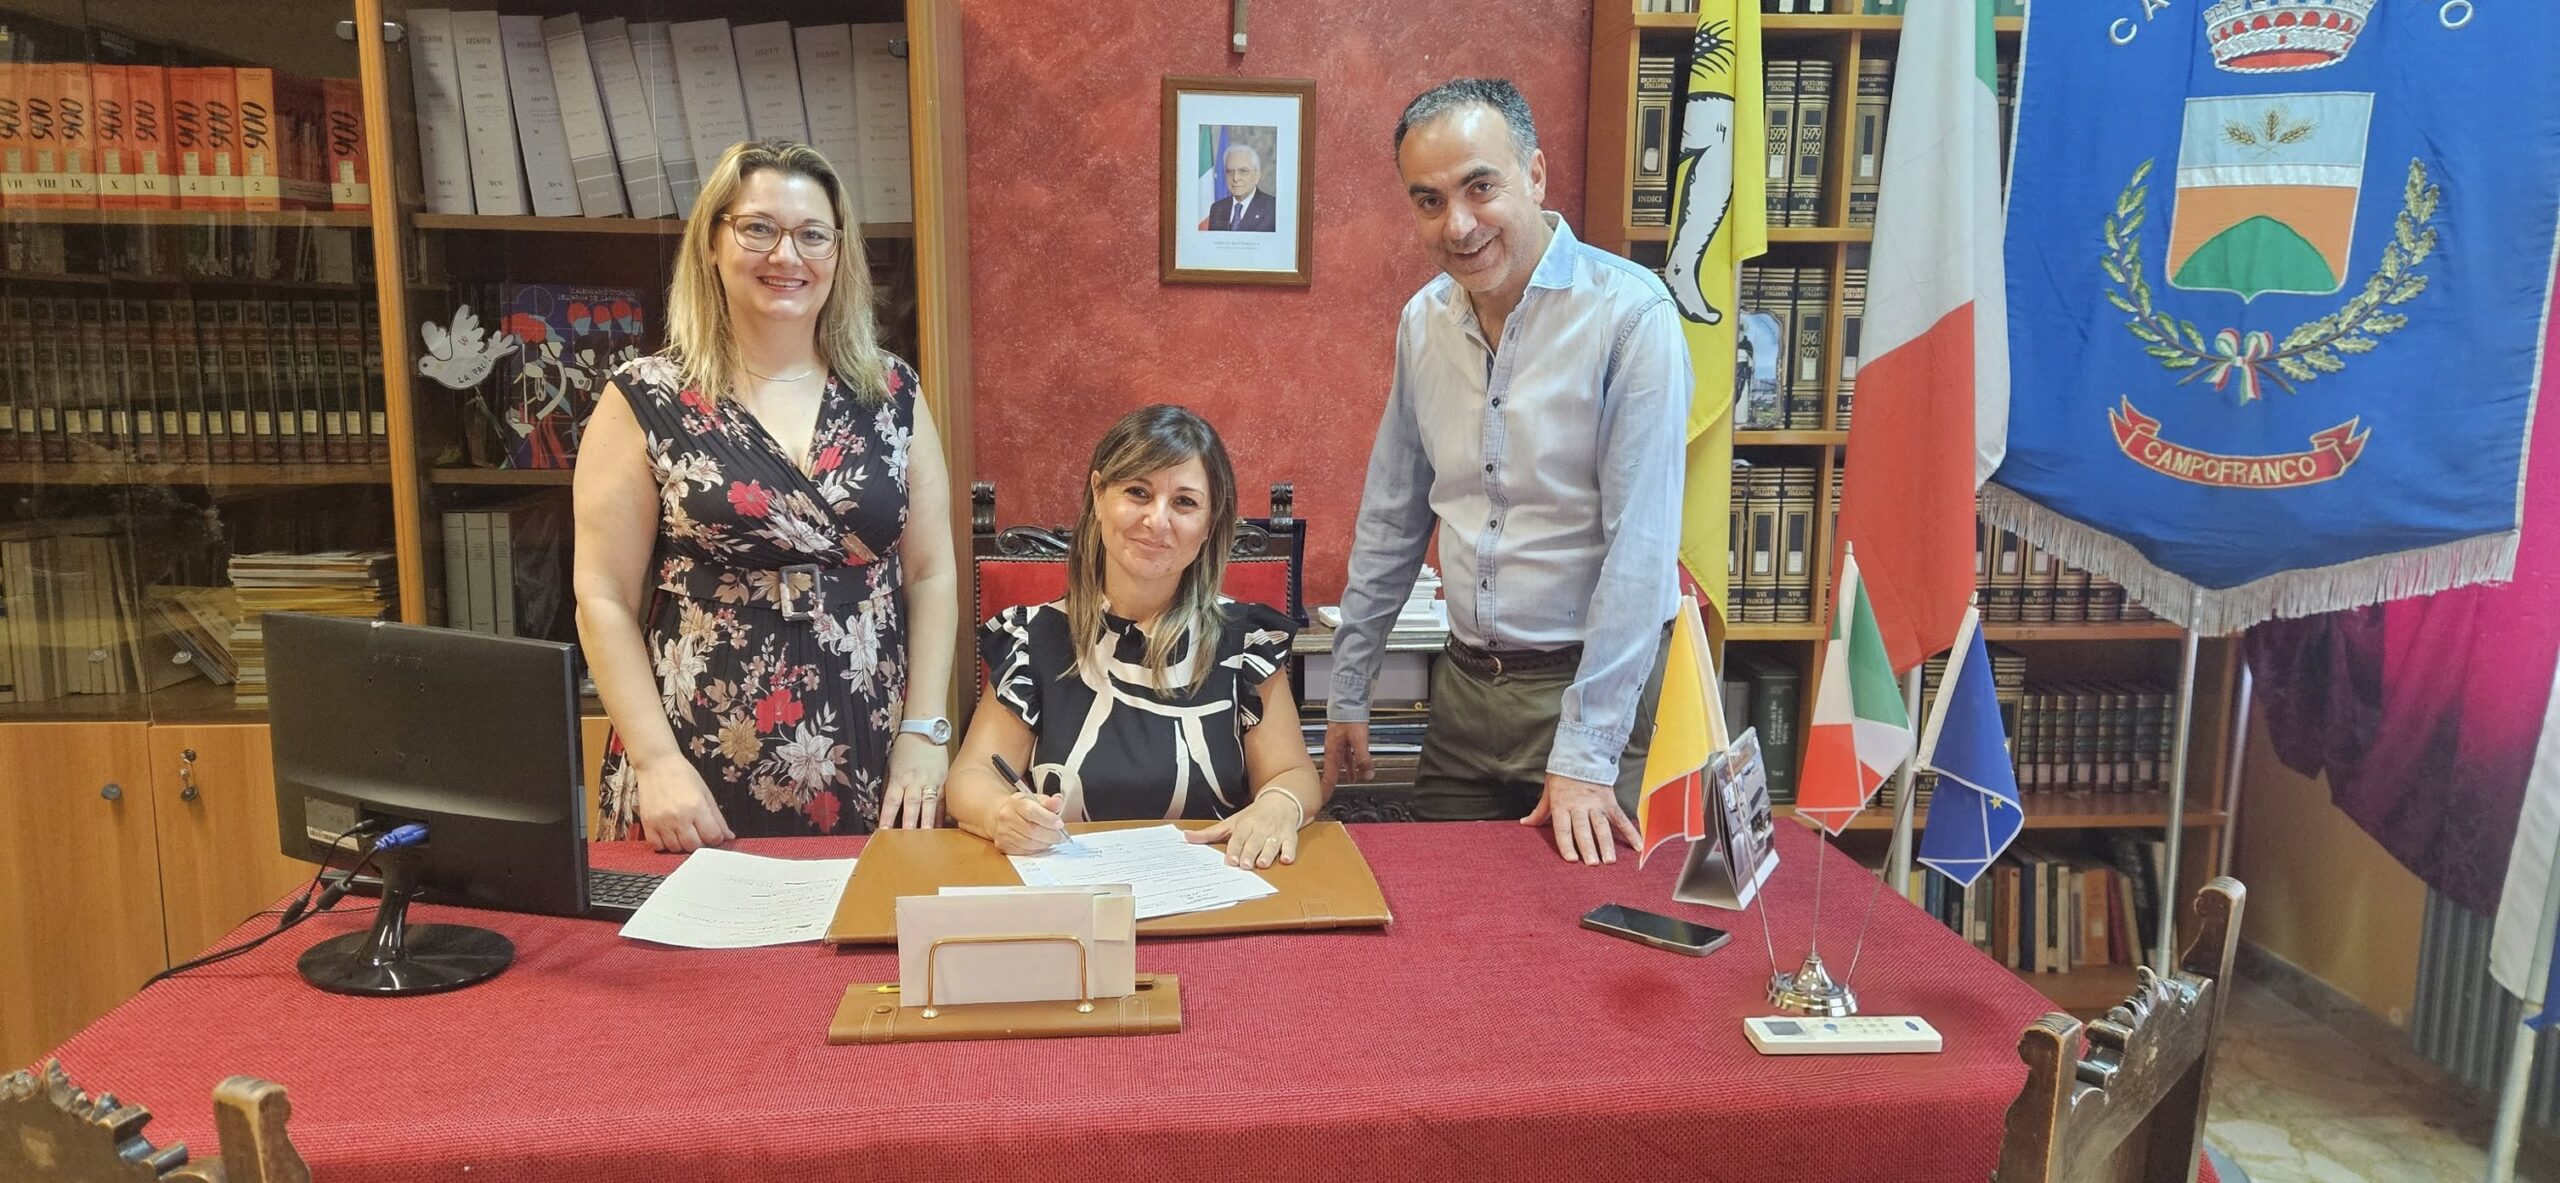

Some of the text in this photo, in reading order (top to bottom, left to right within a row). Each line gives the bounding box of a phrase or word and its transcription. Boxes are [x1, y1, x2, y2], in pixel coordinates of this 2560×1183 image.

[28, 97, 55, 141] 900
[60, 97, 87, 143] 900
[98, 99, 124, 143] 900
[134, 99, 158, 143] 900
[205, 100, 234, 150] 900
[240, 101, 270, 151] 900
[330, 110, 360, 157] 900
[1769, 128, 1787, 141] 1979
[1802, 128, 1821, 141] 1979
[1769, 142, 1786, 154] 1992
[1801, 142, 1820, 155] 1992
[70, 178, 83, 189] IX
[110, 179, 119, 190] X
[253, 181, 261, 191] 2
[345, 187, 352, 198] 3
[1638, 195, 1662, 203] INDICI
[2145, 441, 2317, 485] CAMPOFRANCO
